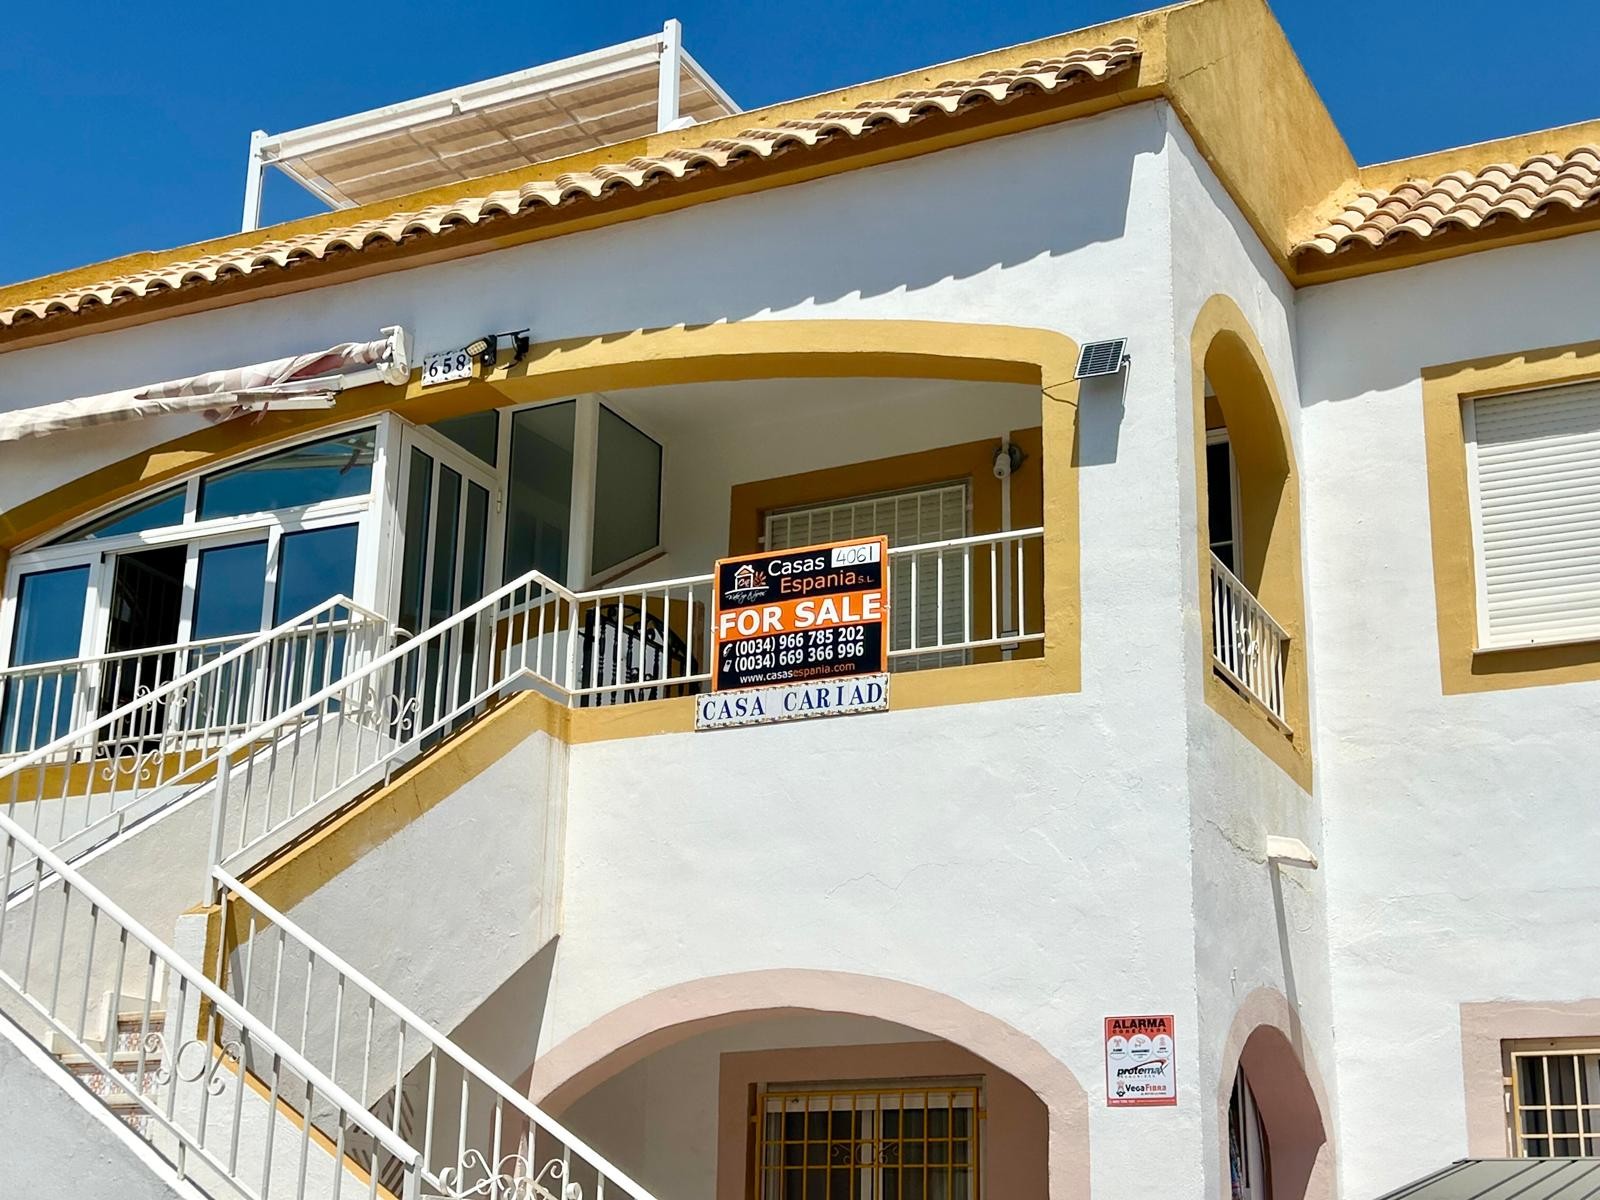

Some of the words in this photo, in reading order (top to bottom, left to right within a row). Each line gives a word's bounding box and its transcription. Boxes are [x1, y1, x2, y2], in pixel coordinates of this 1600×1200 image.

[429, 354, 466, 377] 658
[768, 556, 825, 577] Casas
[835, 546, 873, 565] 4061
[780, 570, 856, 594] Espania
[720, 606, 783, 638] FOR
[794, 593, 882, 628] SALE
[735, 636, 776, 657] (0034)
[779, 632, 804, 649] 966
[808, 629, 834, 645] 785
[838, 626, 864, 642] 202
[734, 652, 776, 672] (0034)
[779, 648, 804, 666] 669
[808, 645, 833, 662] 366
[838, 642, 864, 658] 996
[739, 662, 855, 683] www.casasespania.com
[703, 696, 765, 721] CASA
[783, 682, 883, 712] CARIAD
[1112, 1018, 1167, 1029] ALARMA
